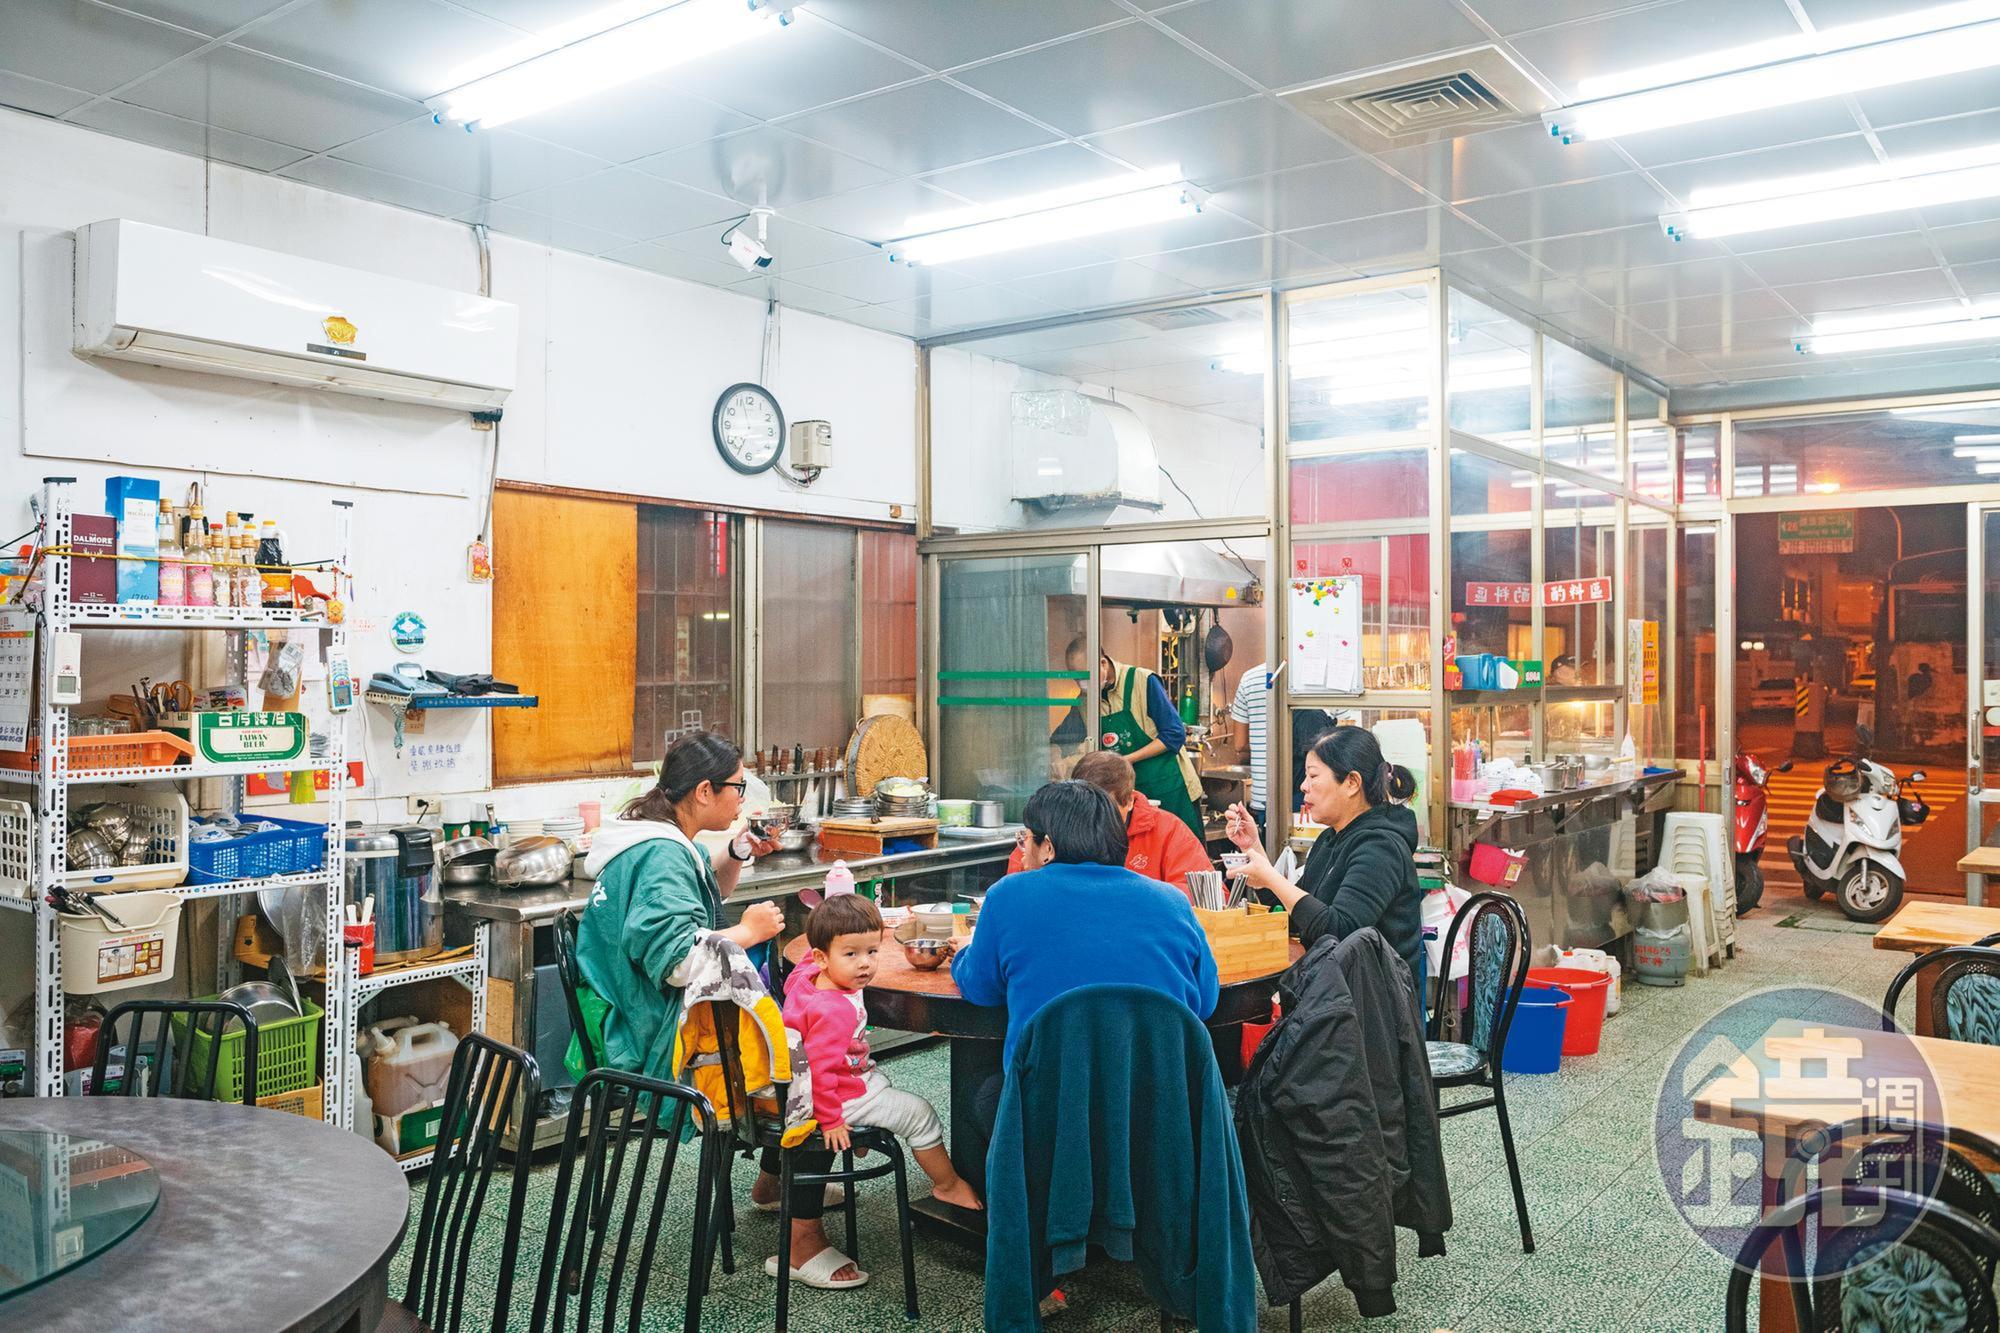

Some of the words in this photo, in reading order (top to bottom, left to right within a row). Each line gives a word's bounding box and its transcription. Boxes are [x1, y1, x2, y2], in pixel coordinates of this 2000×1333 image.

[746, 396, 754, 406] 12
[727, 407, 736, 416] 10
[764, 413, 772, 423] 2
[724, 420, 732, 430] 9
[768, 427, 774, 437] 3
[744, 452, 753, 462] 6
[73, 534, 113, 544] DALMORE
